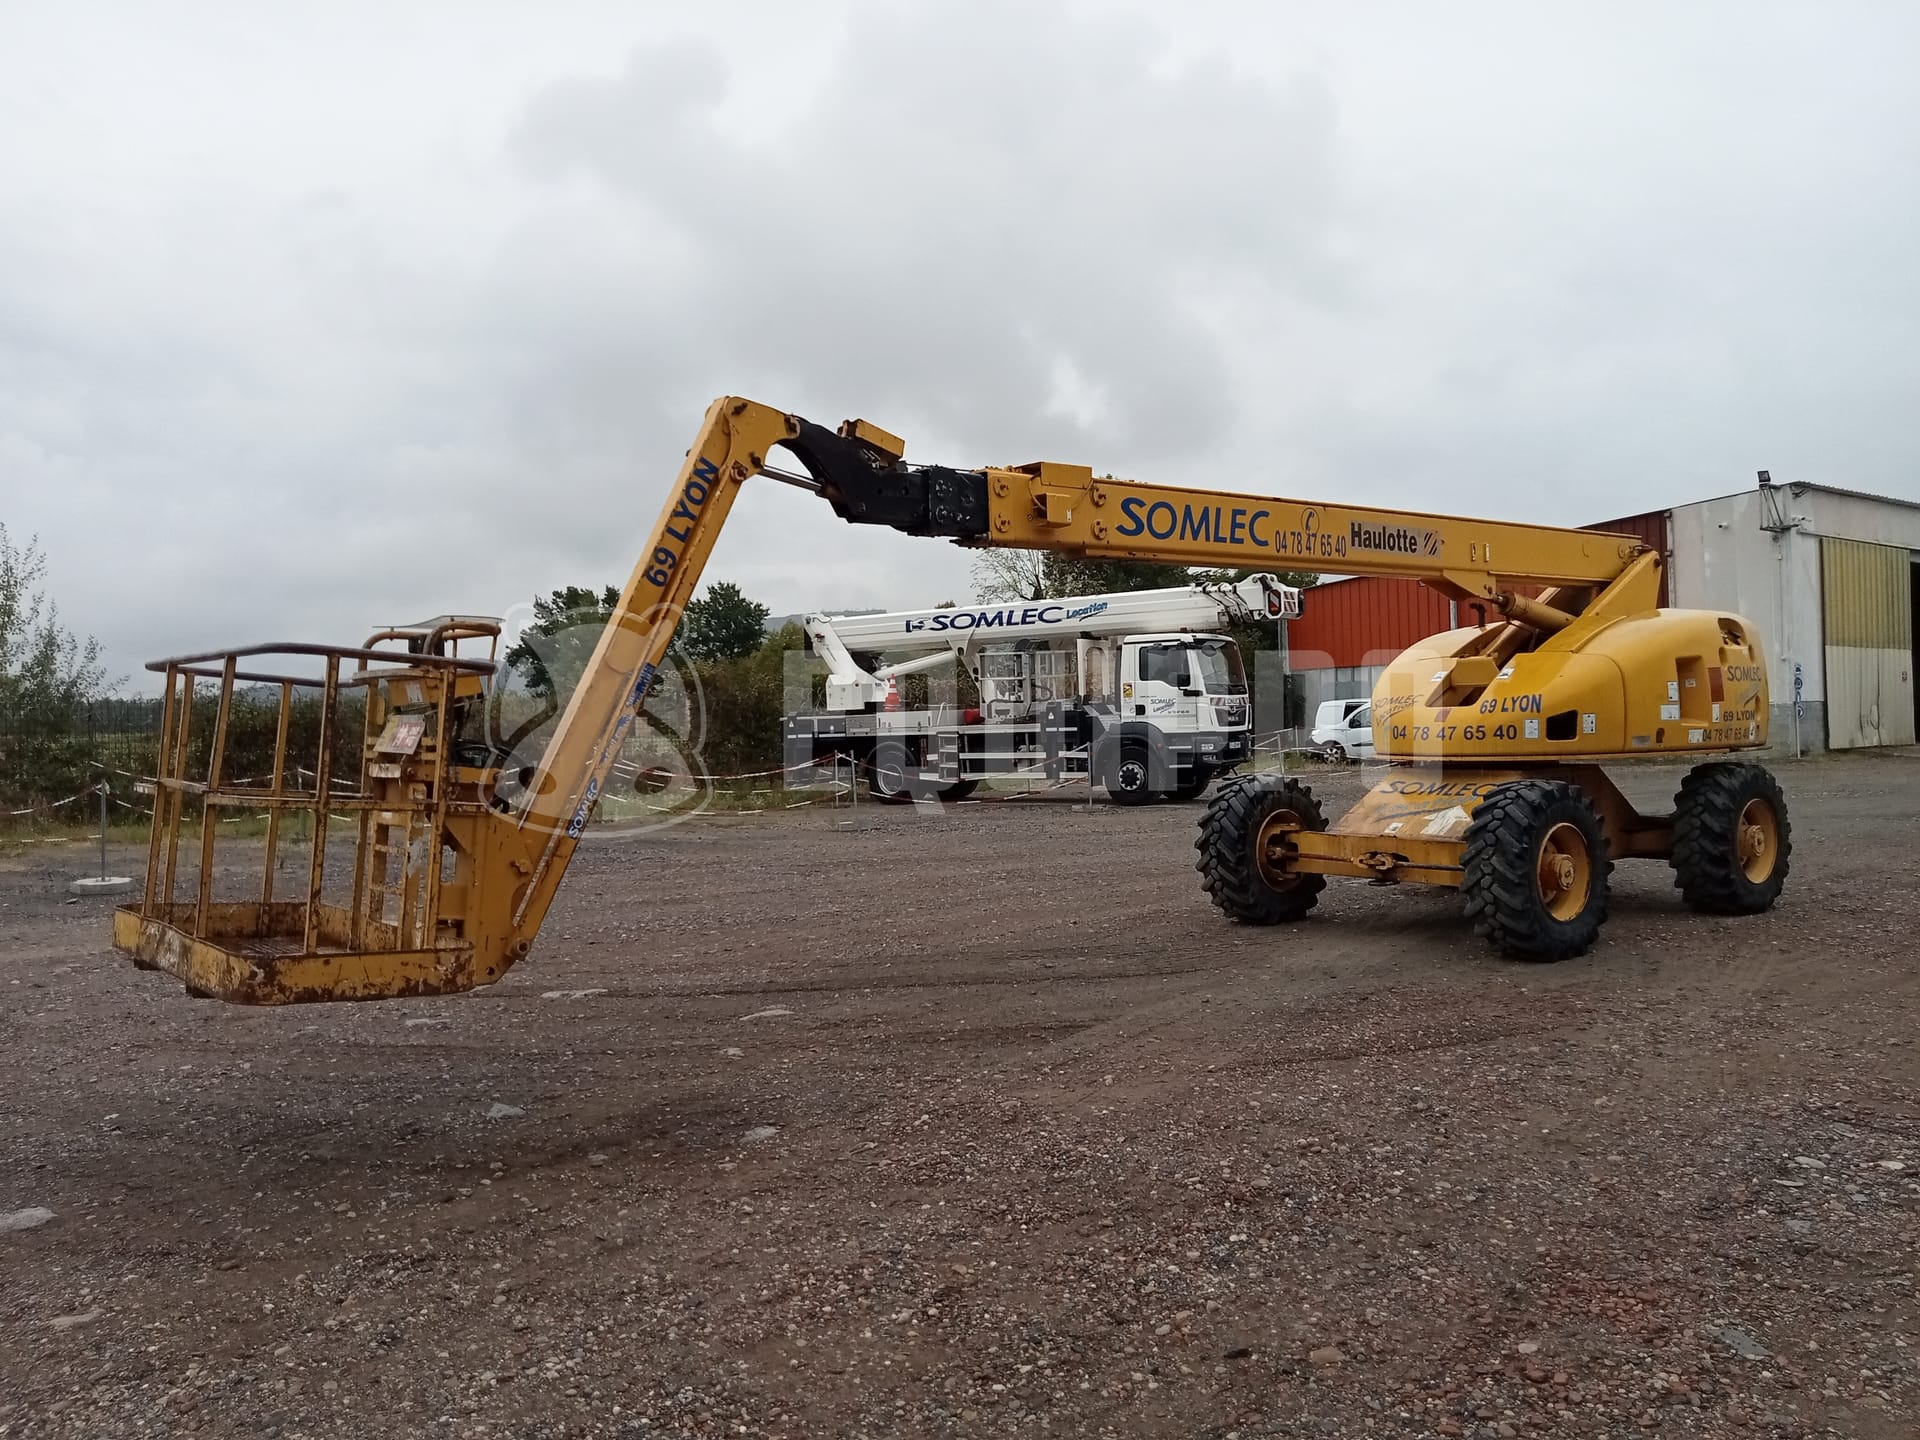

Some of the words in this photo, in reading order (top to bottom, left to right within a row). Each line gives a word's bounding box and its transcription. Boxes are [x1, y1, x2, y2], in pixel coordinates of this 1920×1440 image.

[646, 546, 678, 588] 69
[666, 456, 720, 543] LYON
[1115, 497, 1270, 547] SOMLEC
[1274, 529, 1288, 554] 04
[1290, 531, 1303, 555] 78
[1305, 530, 1318, 556] 47
[1320, 533, 1332, 557] 65
[1334, 535, 1347, 558] 40
[1350, 522, 1418, 554] Haulotte
[929, 606, 1065, 632] SOMLEC
[1727, 665, 1762, 682] SOMLEC
[1374, 694, 1425, 712] SOMLEC
[1480, 699, 1498, 714] 69
[1501, 694, 1542, 714] LYON
[1723, 711, 1734, 722] 69
[1736, 710, 1756, 721] LYON
[1392, 725, 1407, 740] 04
[1413, 726, 1430, 741] 78
[1436, 725, 1457, 741] 47
[1463, 725, 1486, 741] 65
[1493, 724, 1518, 740] 40
[1703, 729, 1712, 742] 04
[1380, 780, 1498, 798] SOMLEC
[568, 780, 599, 839] SOMLEC
